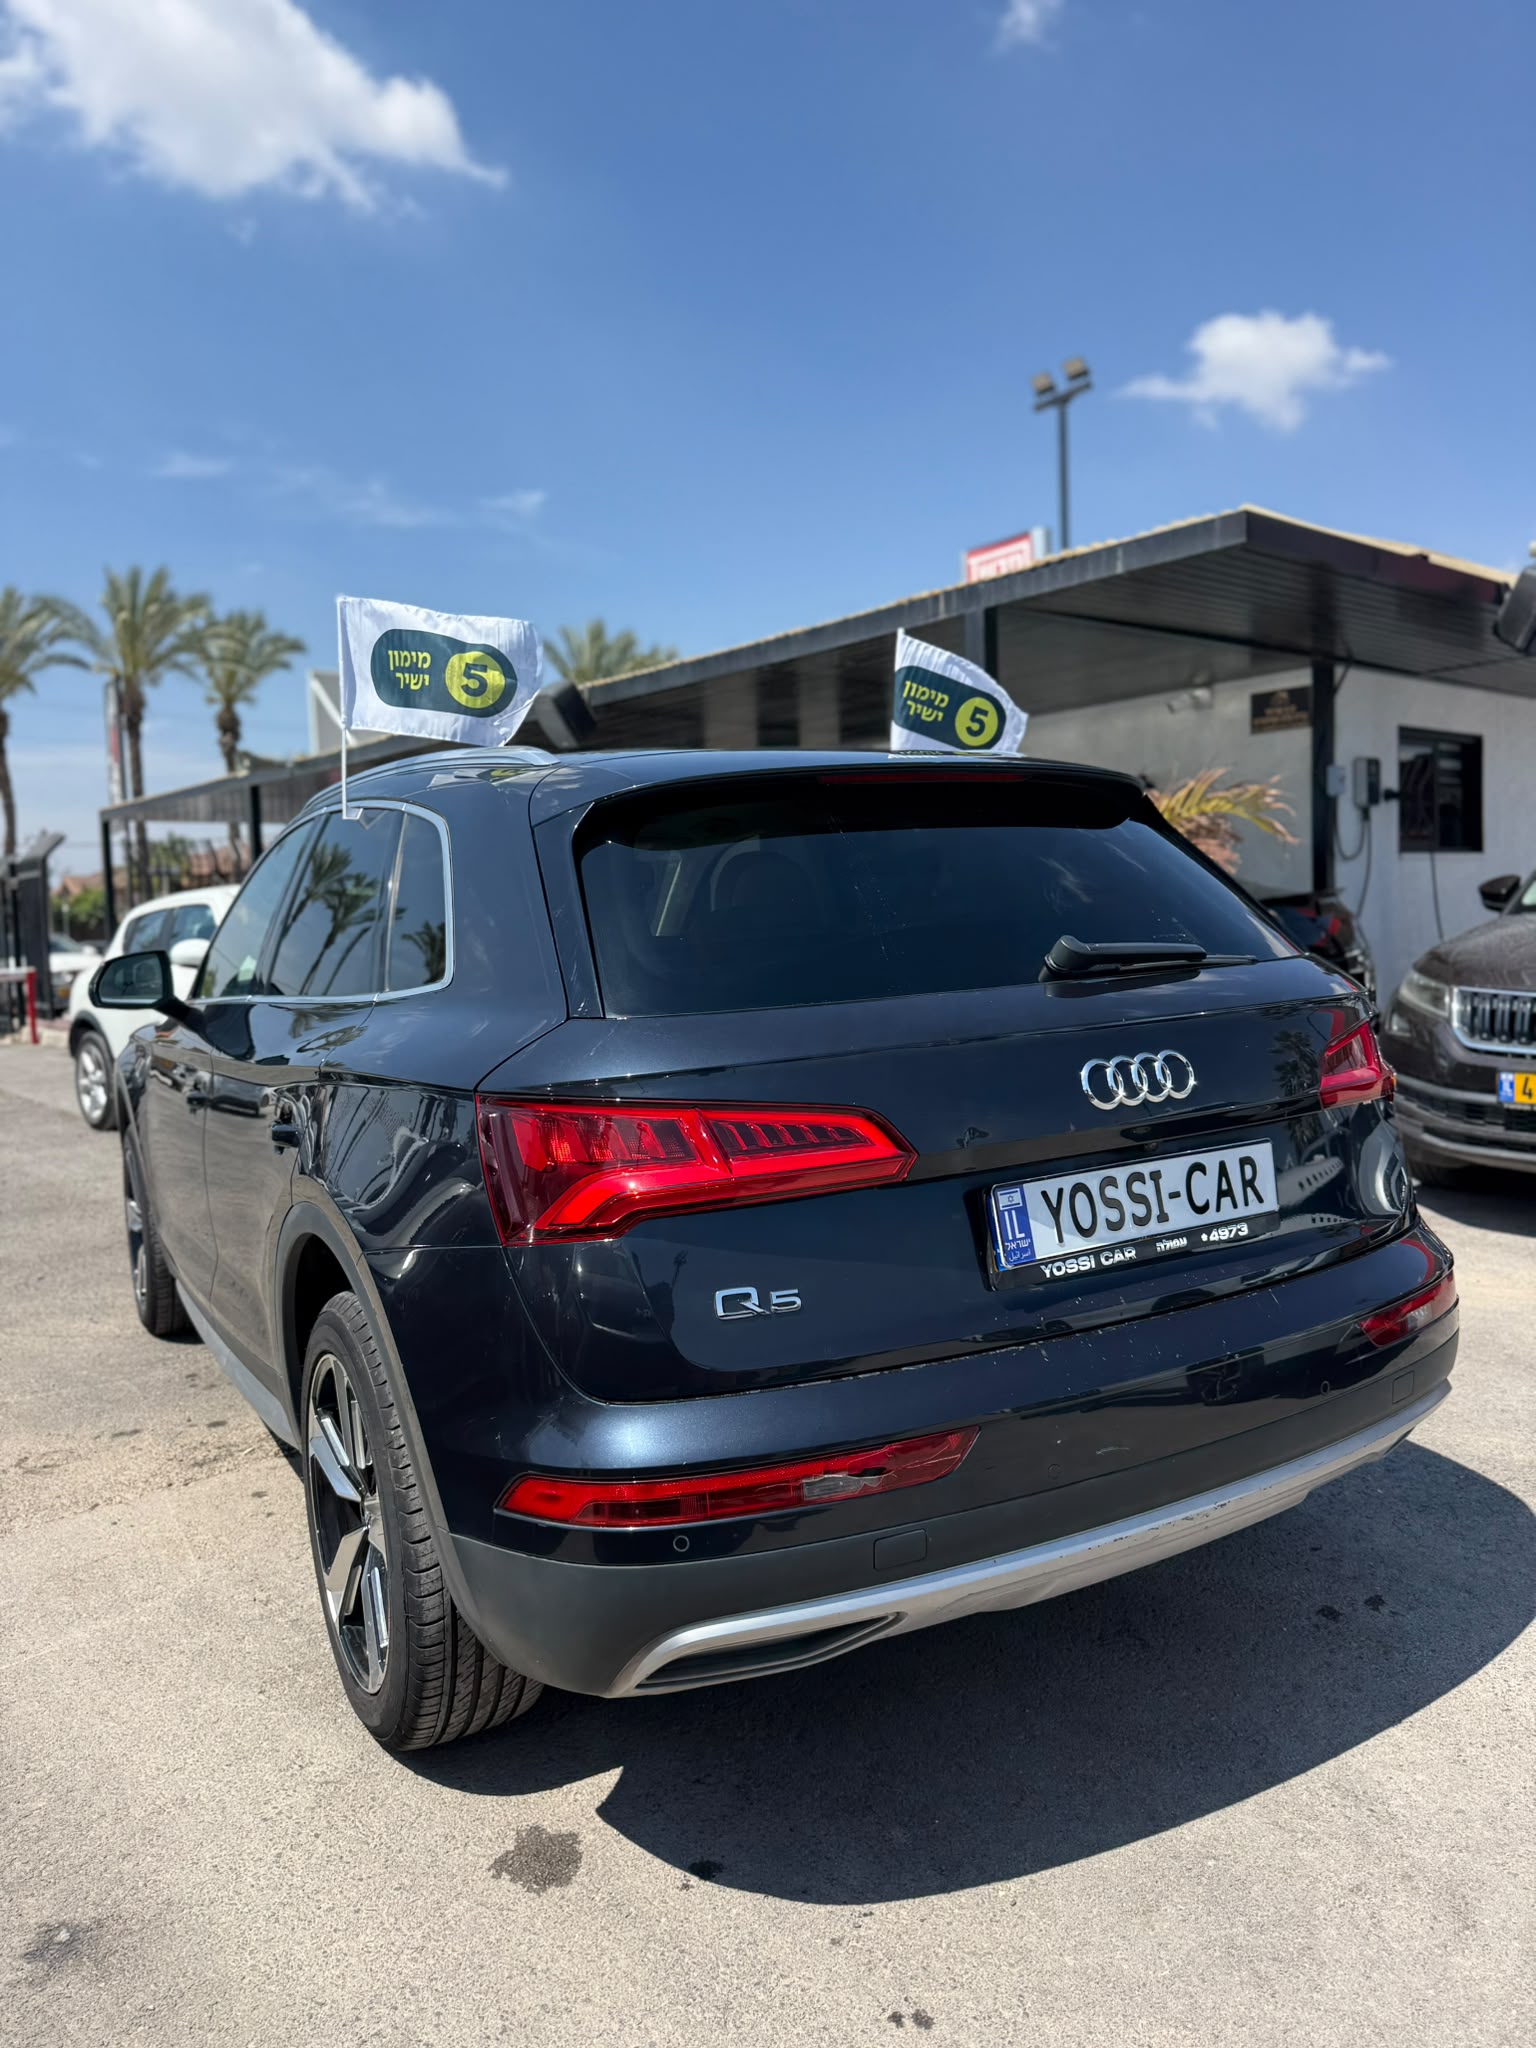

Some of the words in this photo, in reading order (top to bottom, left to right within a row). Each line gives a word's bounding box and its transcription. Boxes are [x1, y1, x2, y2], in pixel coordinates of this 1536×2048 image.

[388, 650, 431, 671] מימון
[395, 672, 430, 690] ישיר
[461, 663, 488, 697] 5
[903, 680, 950, 708] מימון
[906, 700, 944, 722] ישיר
[965, 706, 989, 738] 5
[1522, 1076, 1532, 1100] 4
[1040, 1155, 1265, 1244] YOSSI-CAR
[1004, 1209, 1026, 1241] IL
[1005, 1238, 1031, 1251] ישראל
[1155, 1236, 1188, 1252] עפולה
[1100, 1246, 1137, 1266] CAR
